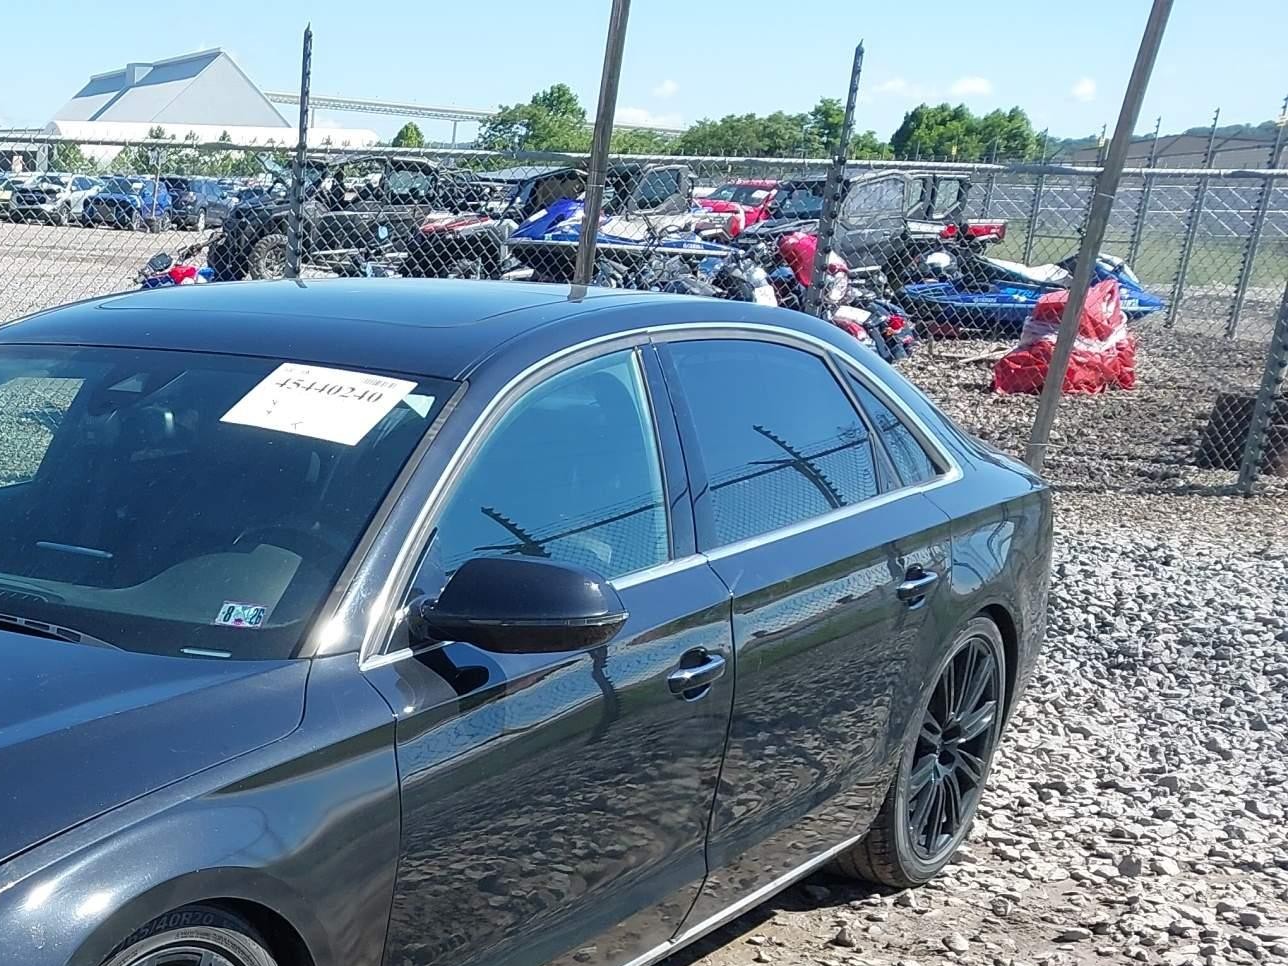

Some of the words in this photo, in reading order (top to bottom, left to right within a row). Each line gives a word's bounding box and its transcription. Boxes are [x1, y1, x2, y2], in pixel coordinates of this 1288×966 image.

[275, 378, 384, 403] 45440240
[222, 605, 235, 623] 8
[248, 607, 266, 625] 26
